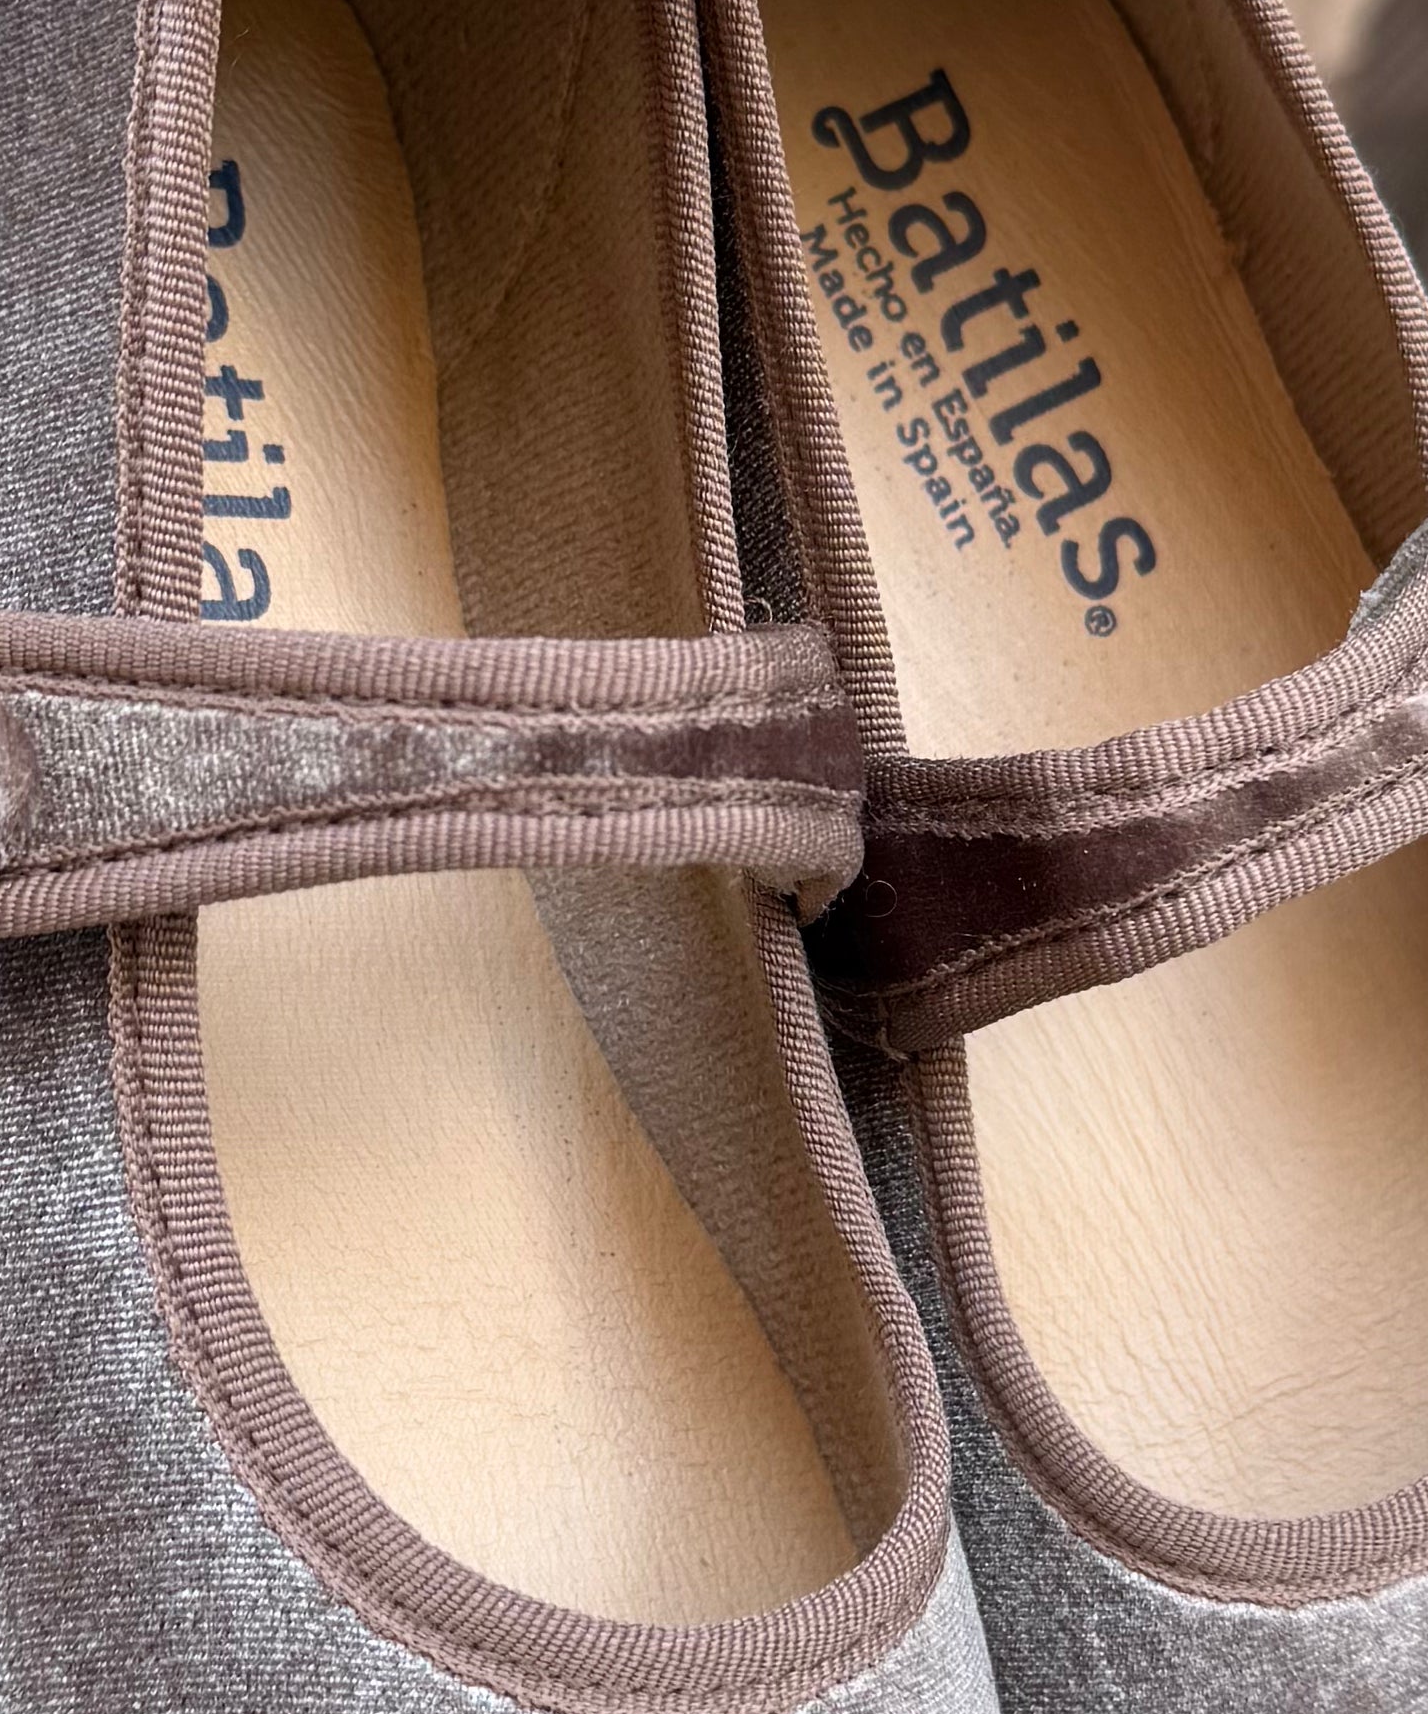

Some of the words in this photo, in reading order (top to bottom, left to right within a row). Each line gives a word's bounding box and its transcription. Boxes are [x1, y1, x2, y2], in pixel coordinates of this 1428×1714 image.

[802, 227, 874, 353] Made
[867, 362, 902, 411] in
[897, 419, 975, 550] Spain
[828, 187, 907, 322] Hecho
[899, 330, 941, 387] en
